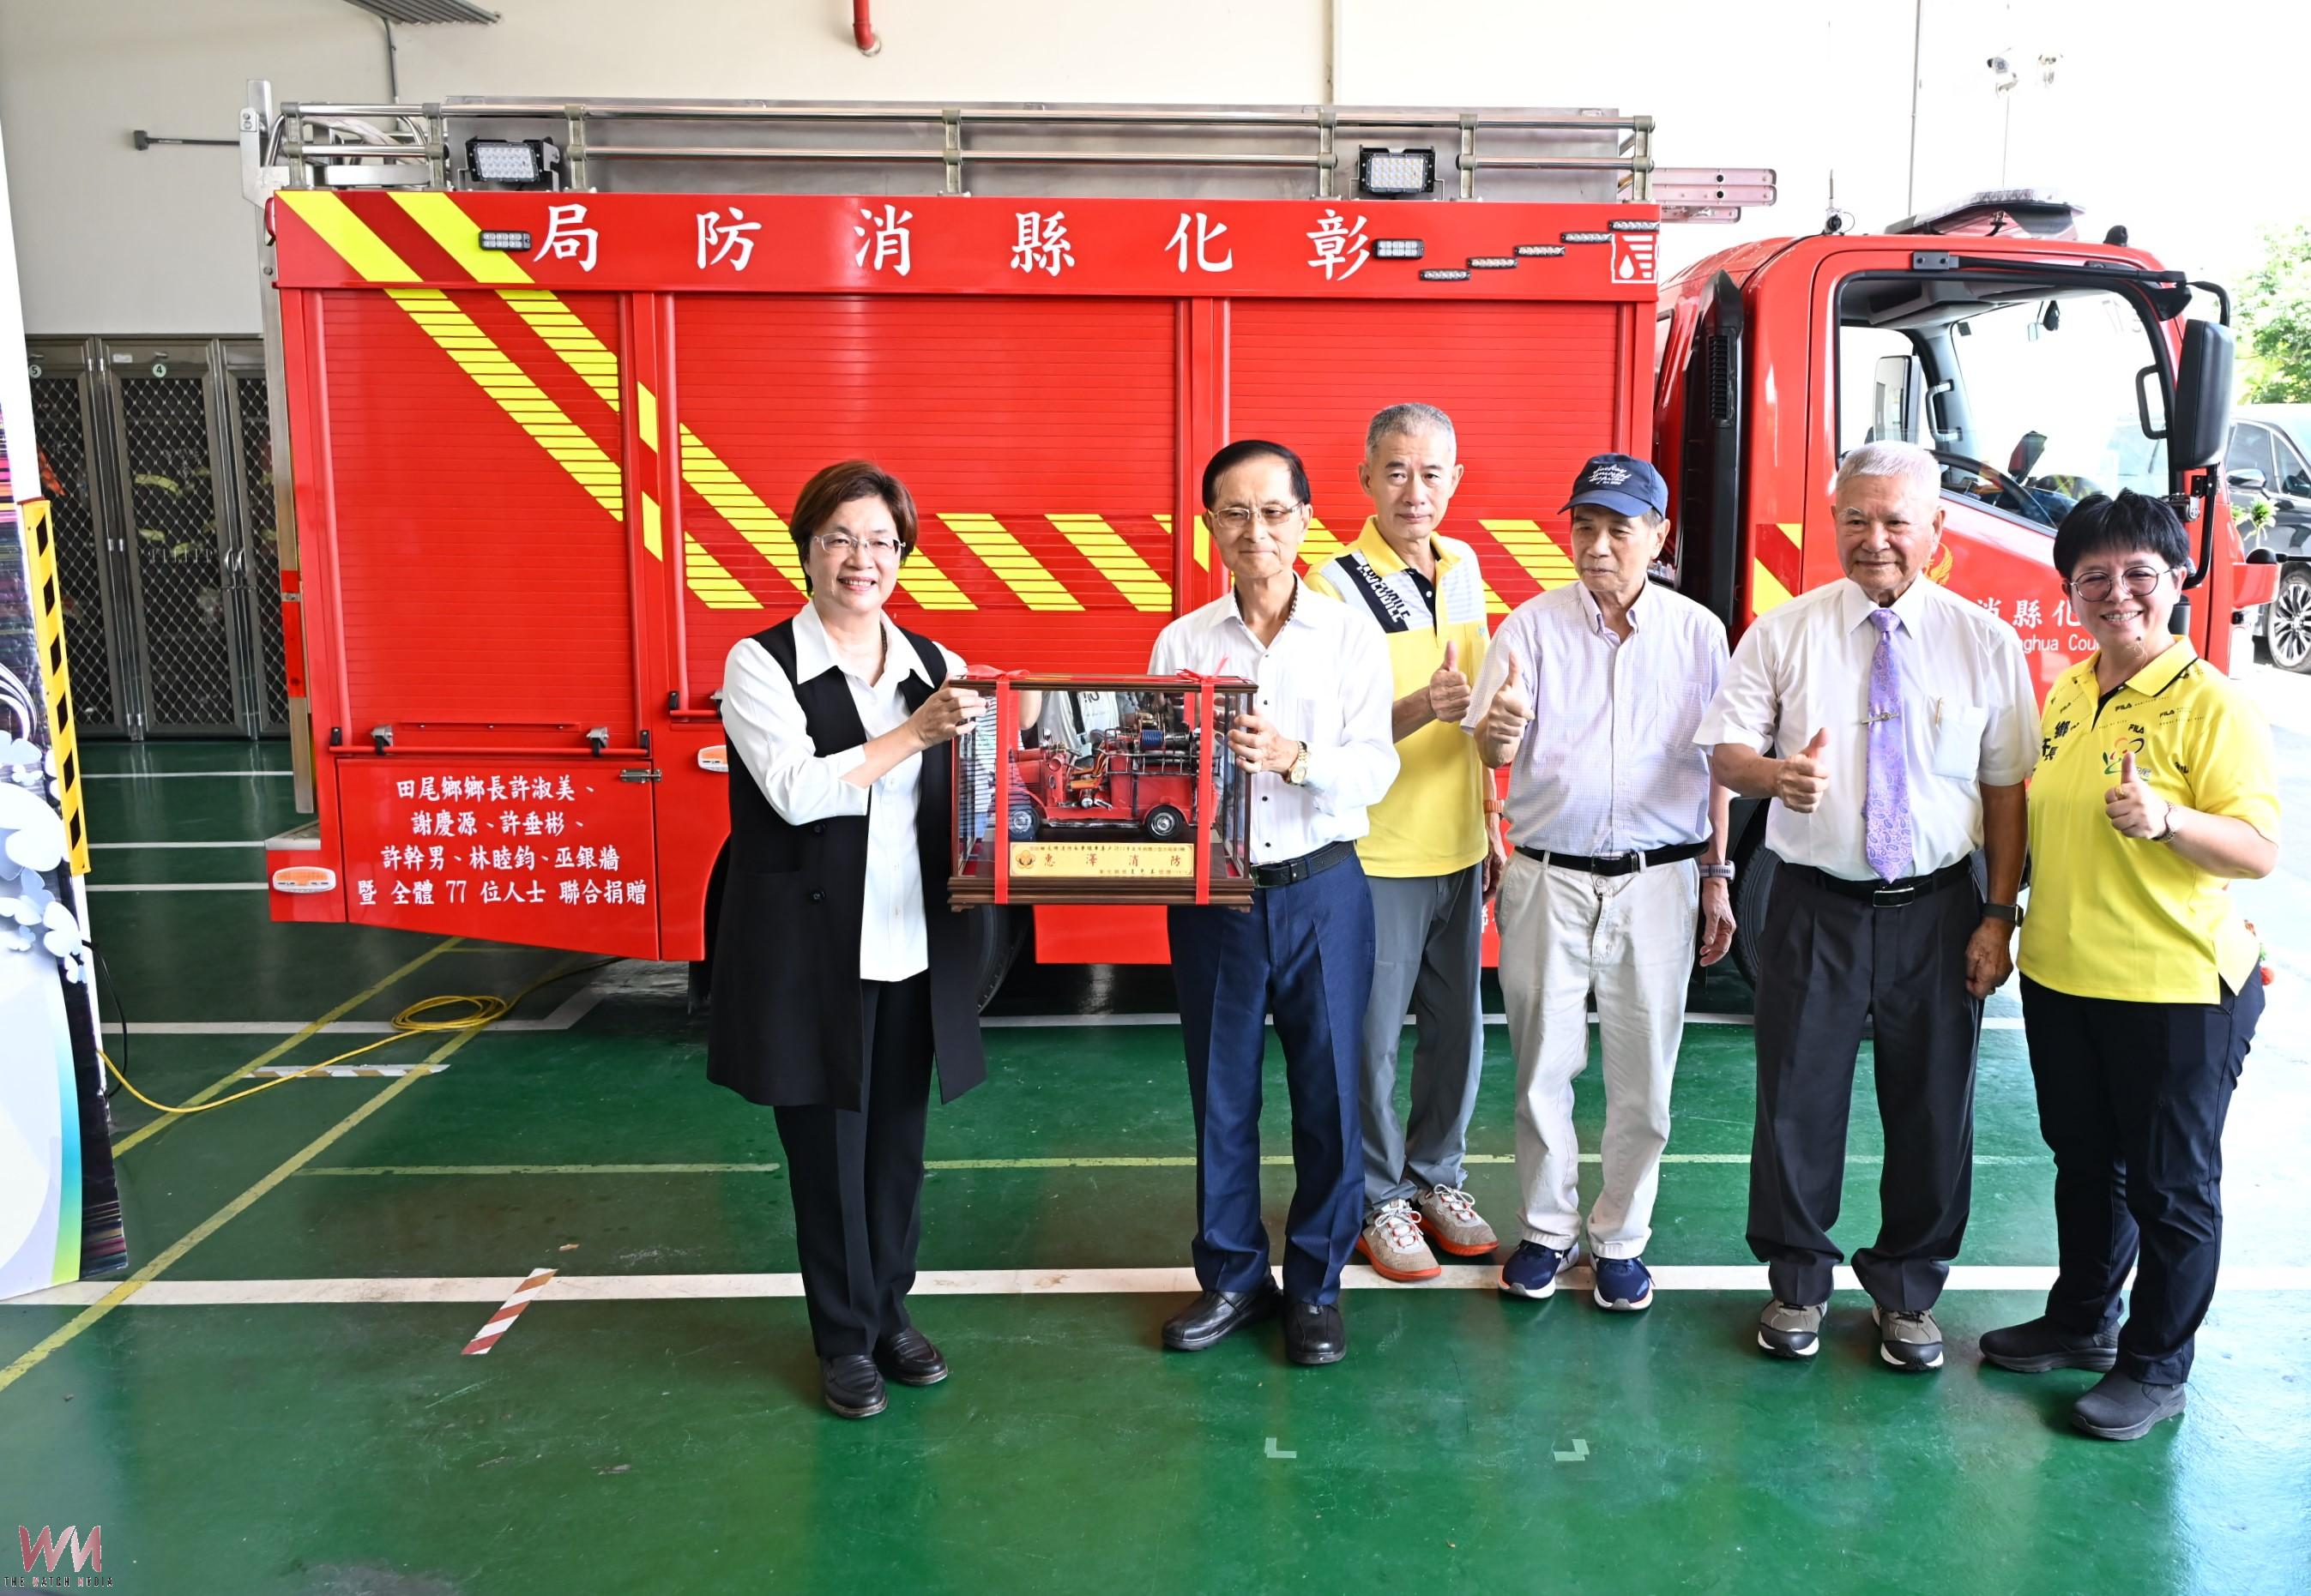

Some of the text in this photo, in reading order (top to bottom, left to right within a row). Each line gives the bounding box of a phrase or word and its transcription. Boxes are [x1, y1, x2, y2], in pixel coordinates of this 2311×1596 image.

[2020, 635, 2058, 654] ghua
[2115, 702, 2133, 712] FILA
[2159, 709, 2175, 719] FILA
[2127, 723, 2145, 734] FILA
[357, 879, 647, 906] 暨 全體 77 位人士 聯合捐贈
